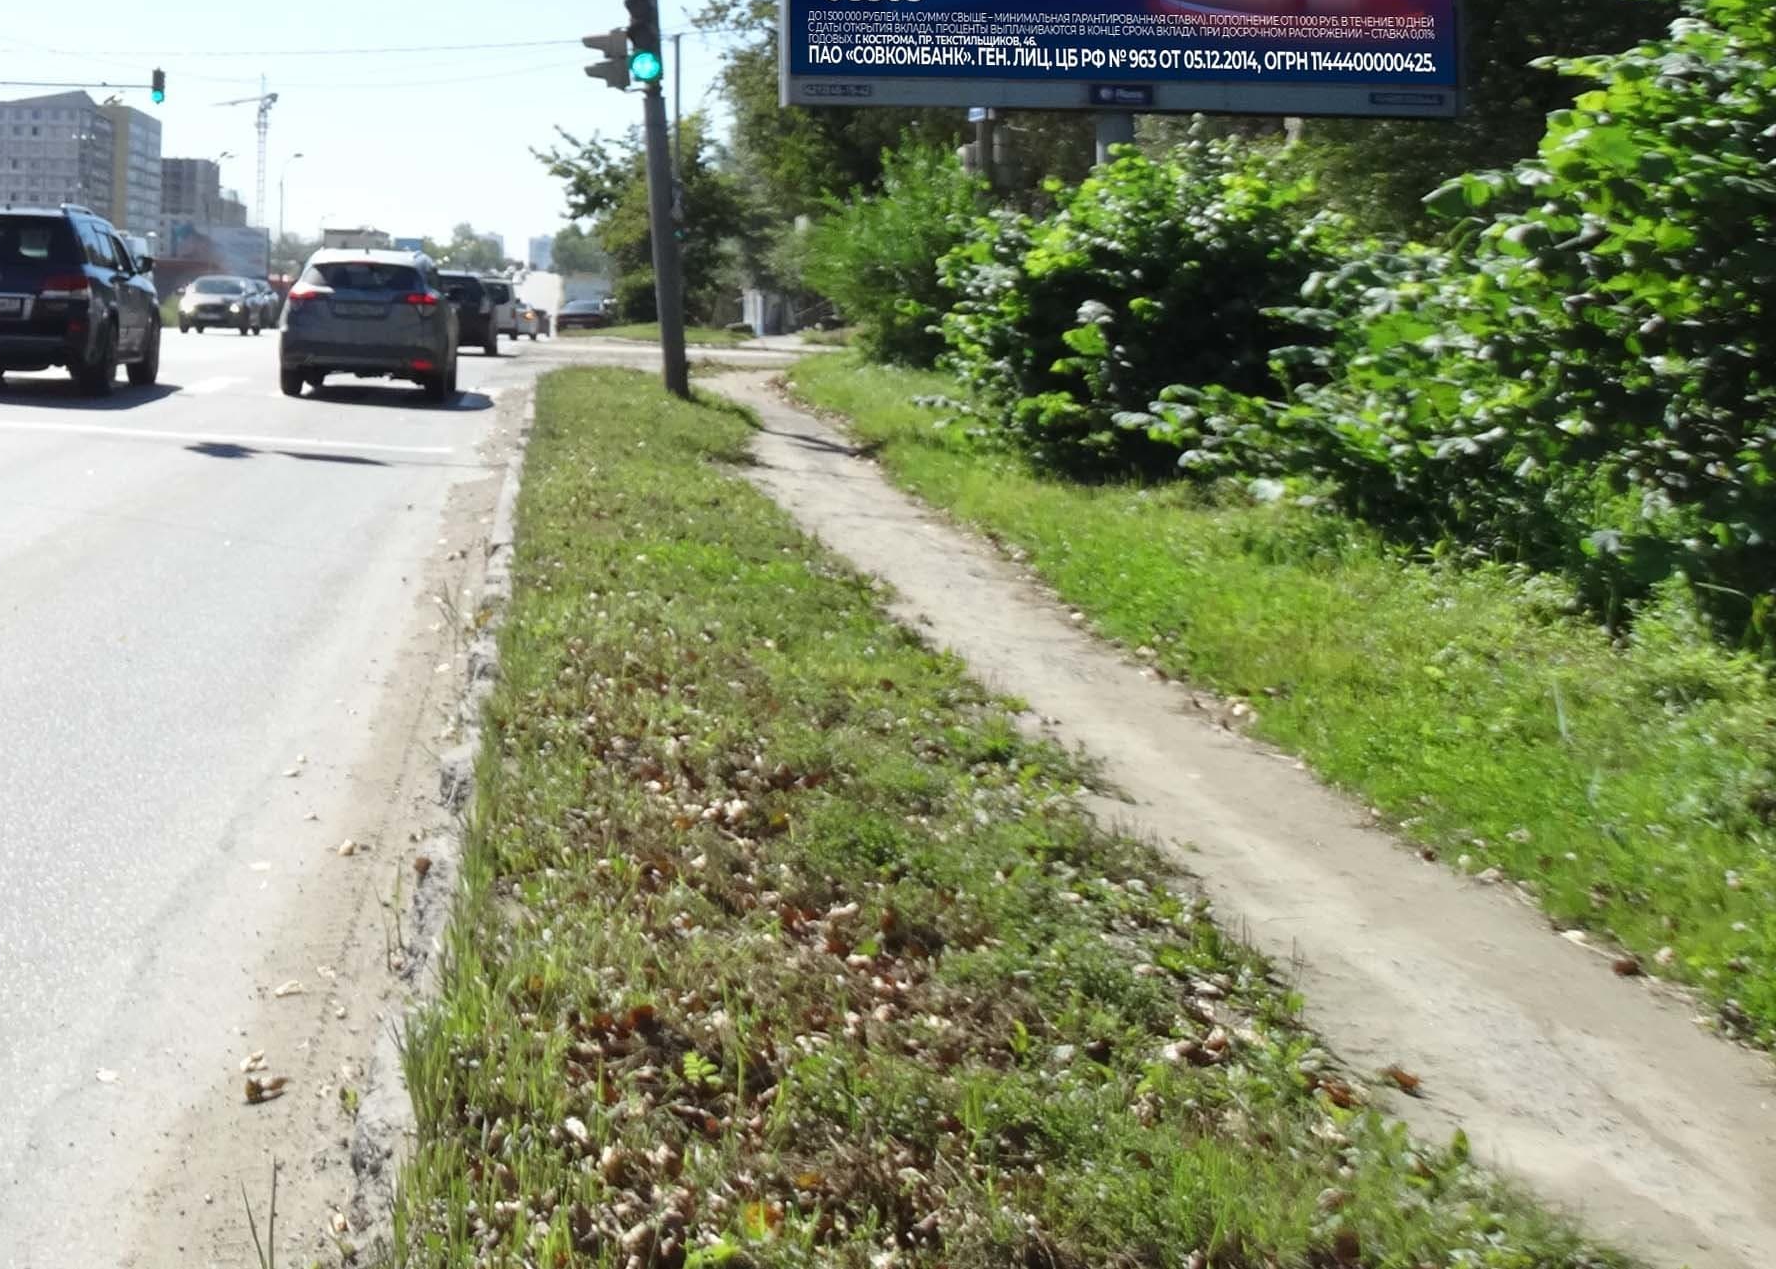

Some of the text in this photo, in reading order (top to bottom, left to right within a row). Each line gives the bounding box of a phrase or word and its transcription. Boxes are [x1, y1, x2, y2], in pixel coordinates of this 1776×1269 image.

[809, 46, 1436, 73] ПАО «СОВКОМБАНК». ГЕН. ЛИЦ. ЦБ РФ № 963 ОТ 05.12.2014, ОГРН 1144400000425.
